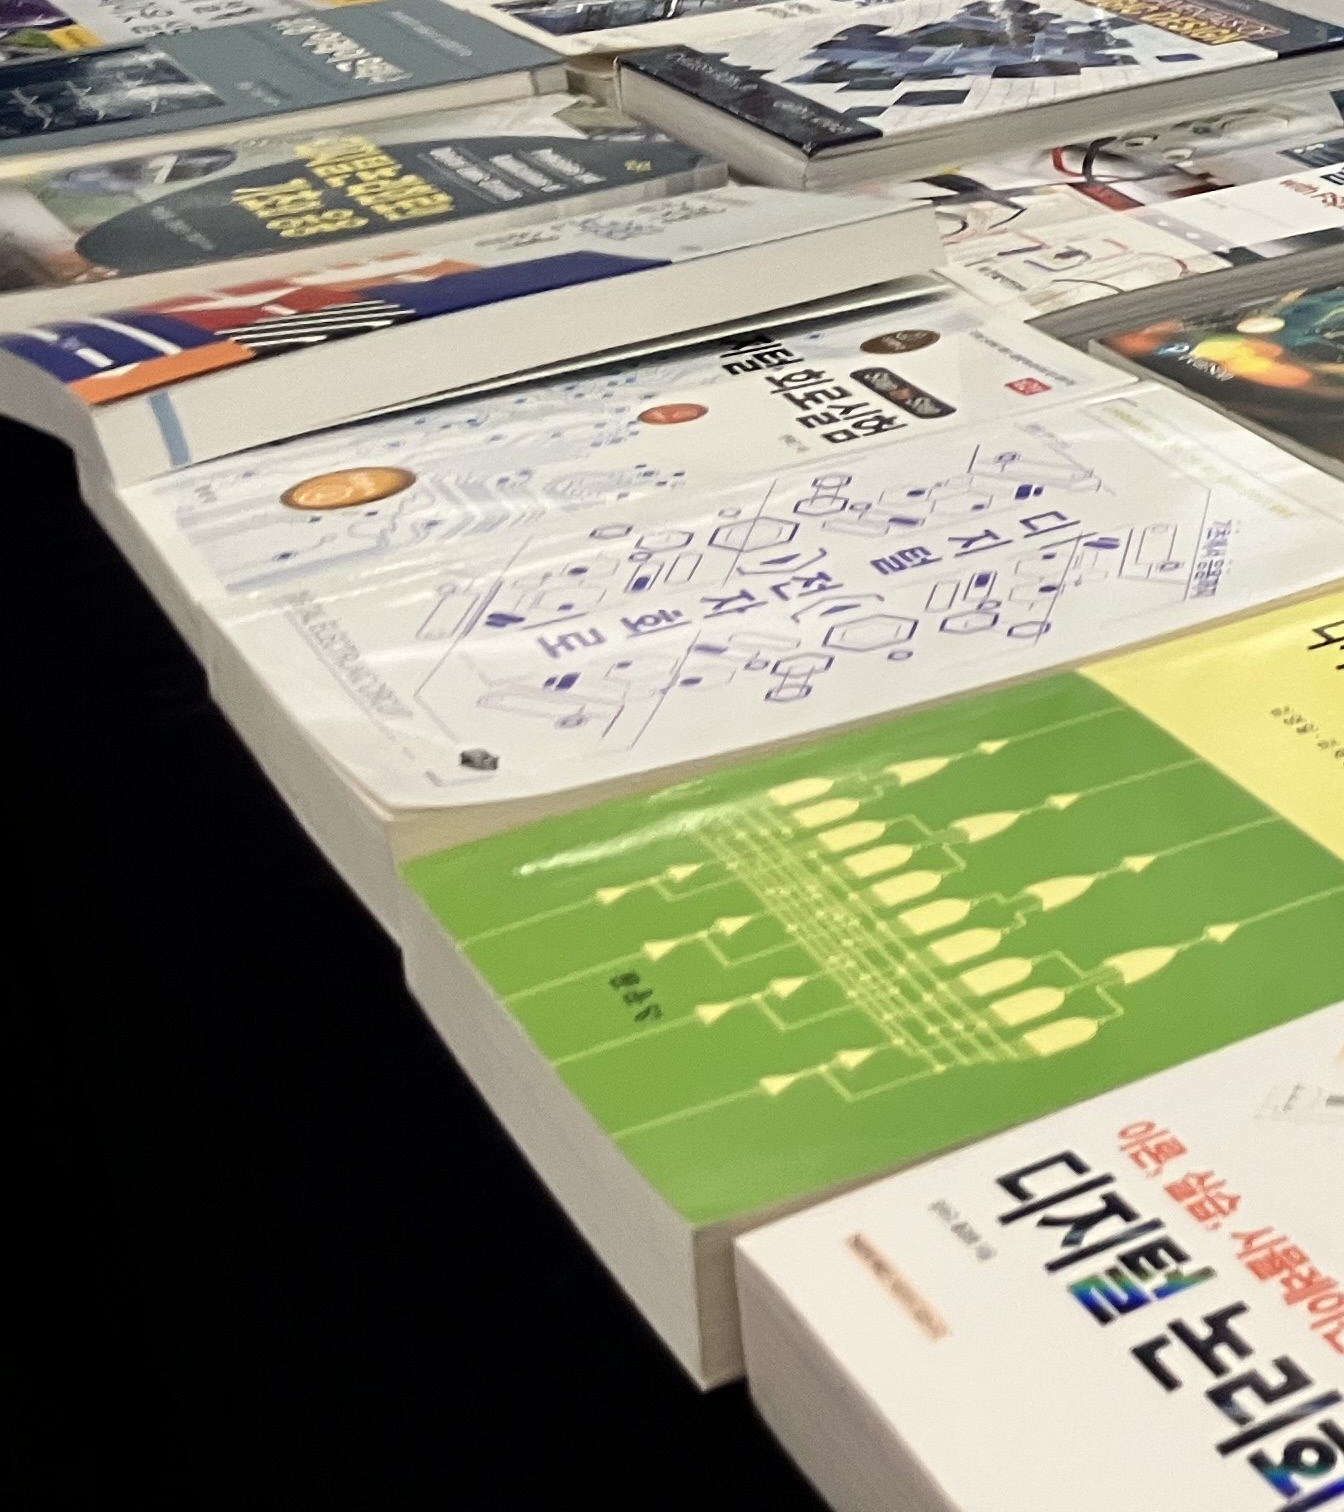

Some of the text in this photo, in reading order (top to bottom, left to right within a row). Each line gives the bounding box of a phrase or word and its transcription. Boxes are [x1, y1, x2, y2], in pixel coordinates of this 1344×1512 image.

[1278, 176, 1318, 198] with
[762, 367, 909, 445] 회로실험
[994, 1149, 1218, 1326] 디지털
